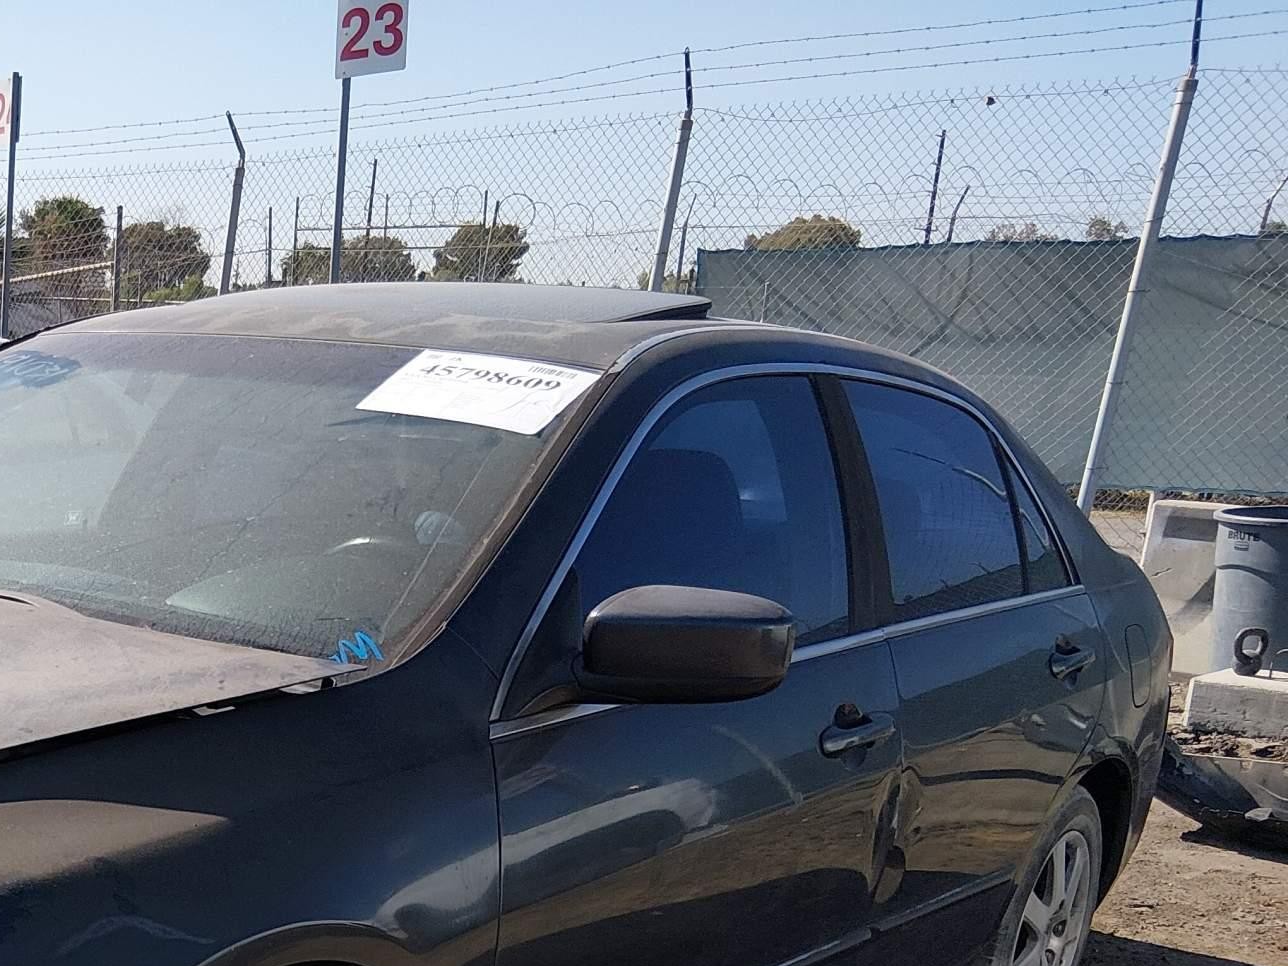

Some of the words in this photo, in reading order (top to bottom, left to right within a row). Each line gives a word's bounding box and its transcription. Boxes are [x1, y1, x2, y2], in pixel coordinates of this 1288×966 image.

[340, 3, 405, 61] 23
[419, 364, 561, 391] 45798609
[1227, 528, 1261, 541] BRUTE
